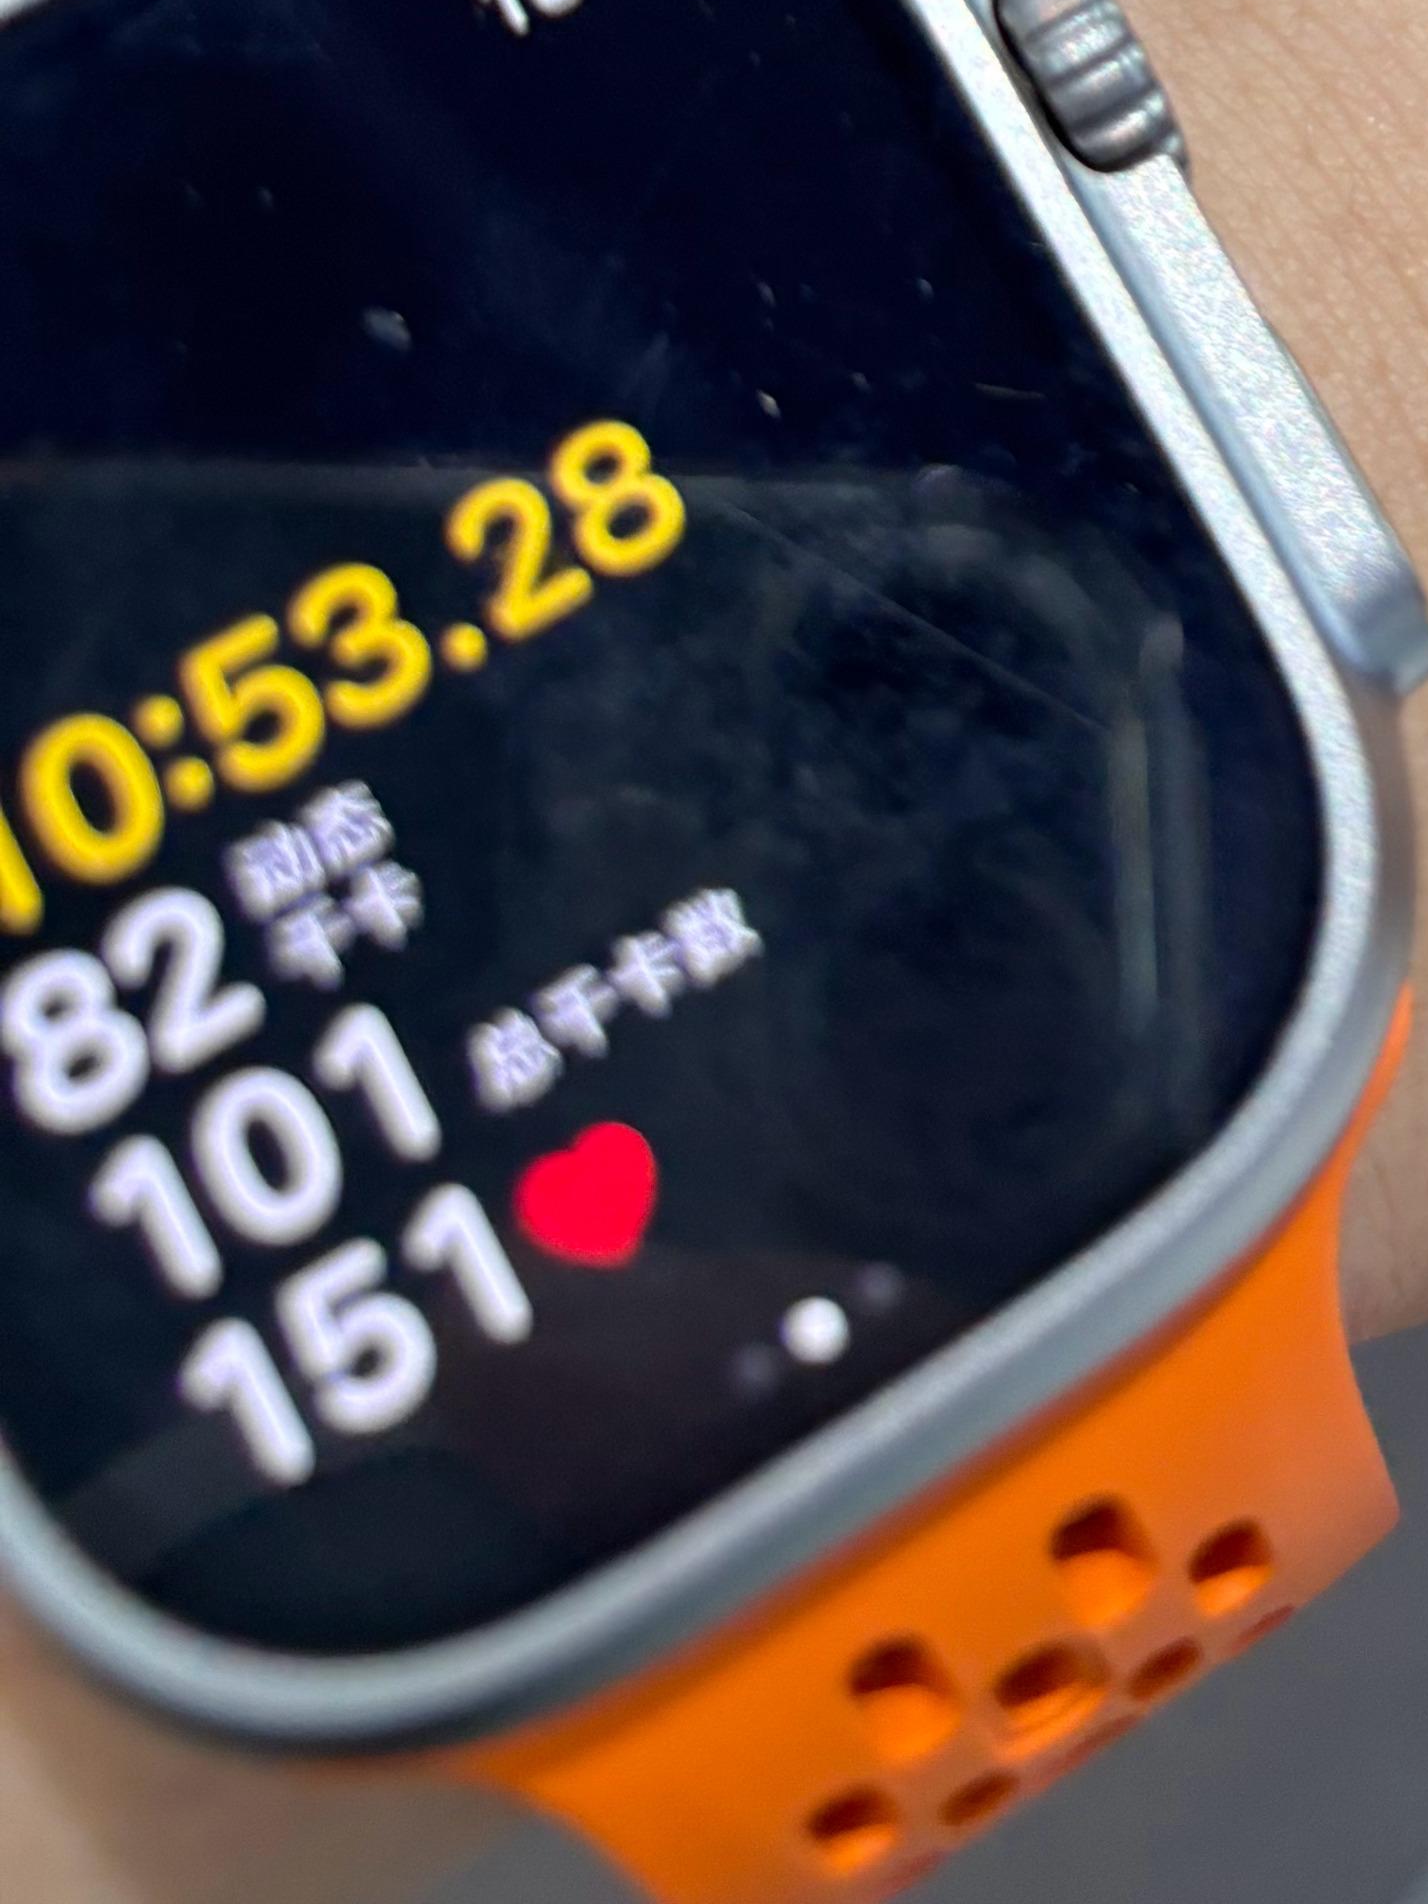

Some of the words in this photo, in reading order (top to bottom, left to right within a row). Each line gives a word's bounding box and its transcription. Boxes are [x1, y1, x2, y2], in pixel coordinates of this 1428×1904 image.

[231, 780, 394, 923] 动态
[270, 862, 422, 988] 千卡
[0, 889, 266, 1134] 82
[90, 1004, 440, 1296] 101
[468, 888, 763, 1109] 总千卡数
[180, 1184, 533, 1482] 151
